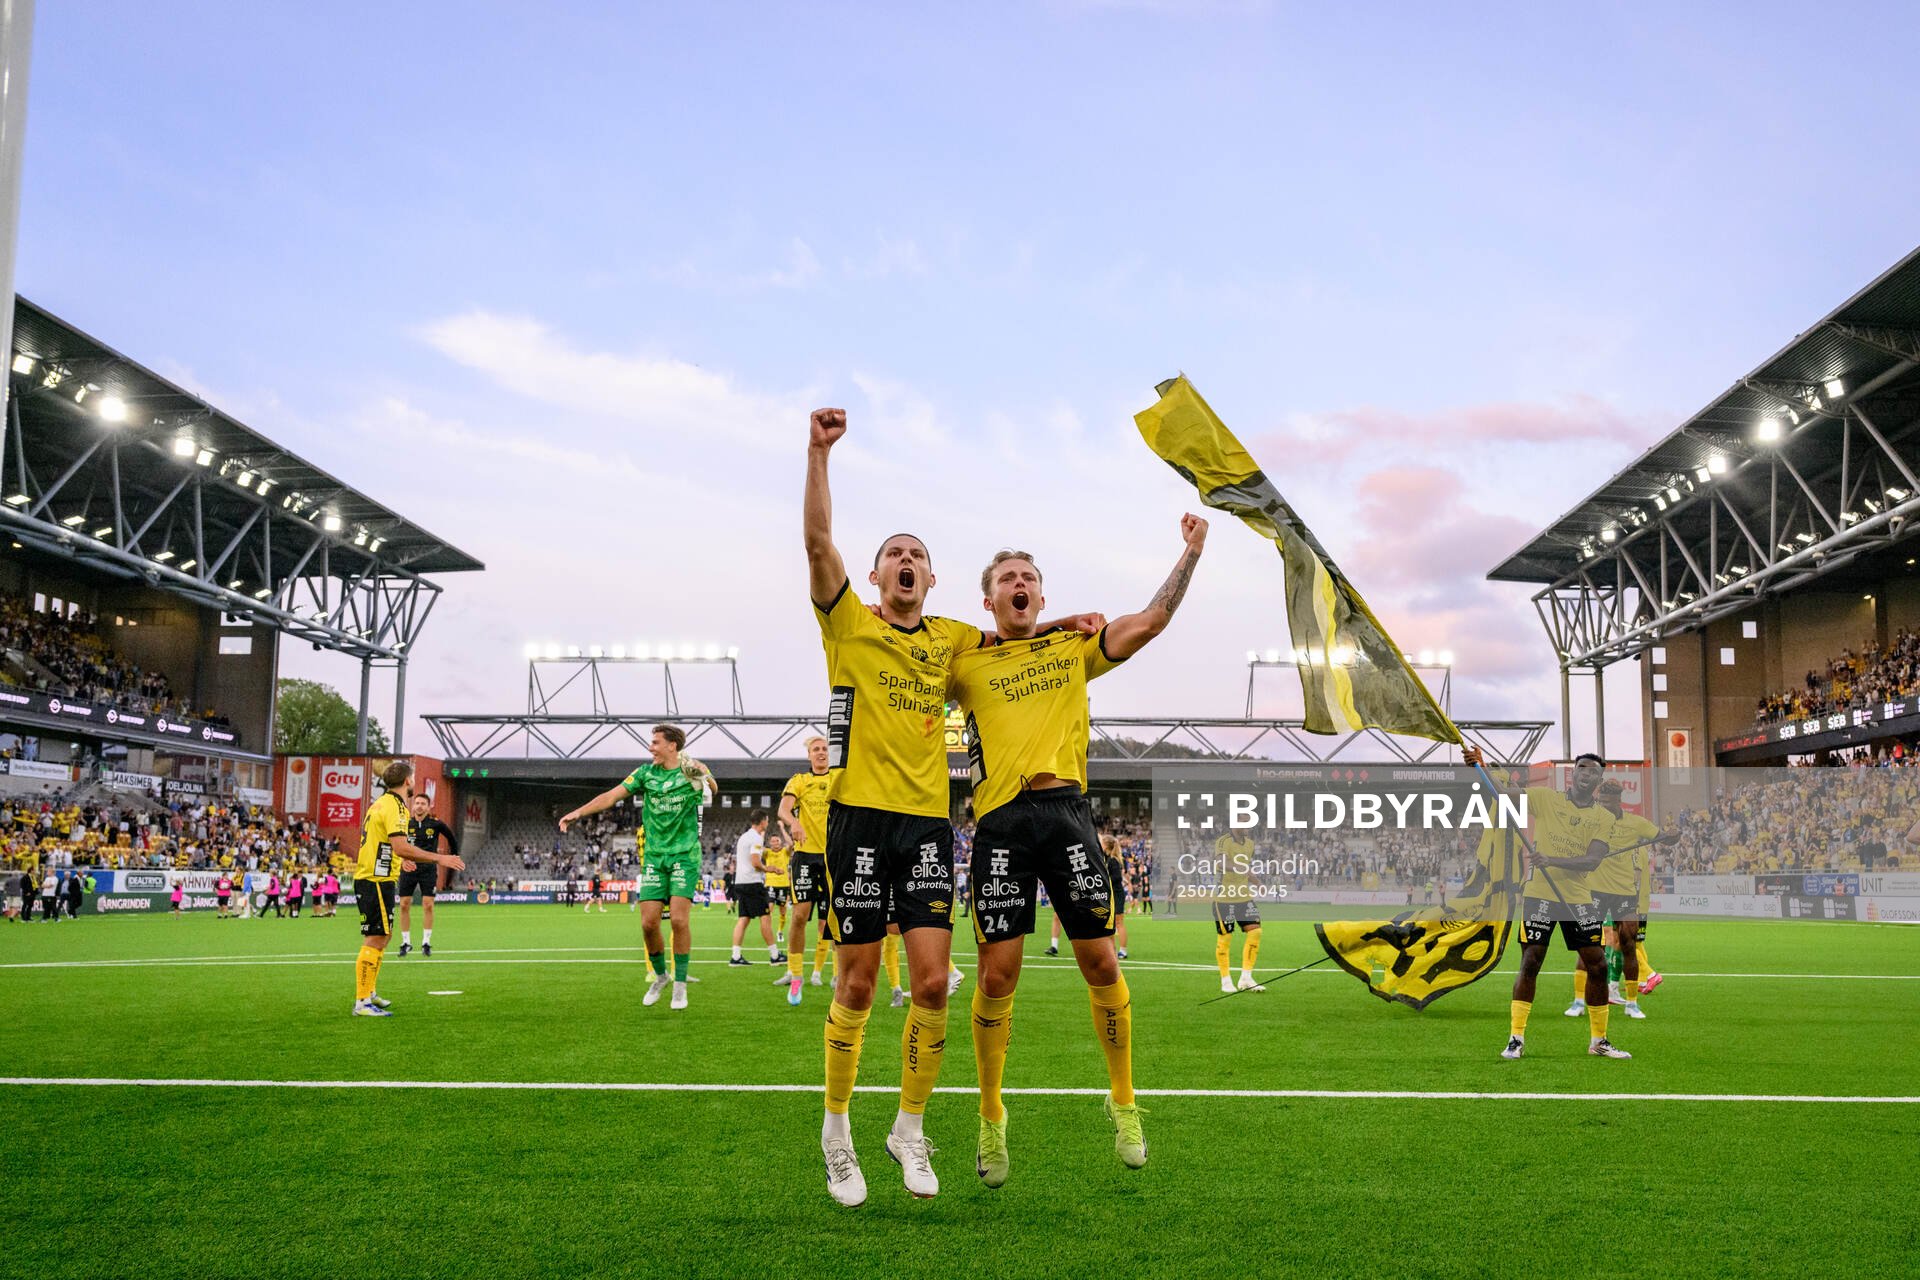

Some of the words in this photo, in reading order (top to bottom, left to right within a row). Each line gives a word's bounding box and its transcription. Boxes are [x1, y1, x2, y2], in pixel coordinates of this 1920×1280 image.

[989, 656, 1079, 692] Sparbanken
[1004, 672, 1070, 703] Sjuhärad
[912, 863, 949, 878] ellos
[843, 876, 881, 896] ellos
[981, 877, 1020, 897] ellos
[1068, 873, 1104, 891] ellos
[842, 916, 853, 935] 6
[984, 914, 1009, 933] 24
[1527, 930, 1542, 940] 29
[1106, 1009, 1119, 1045] ARDY
